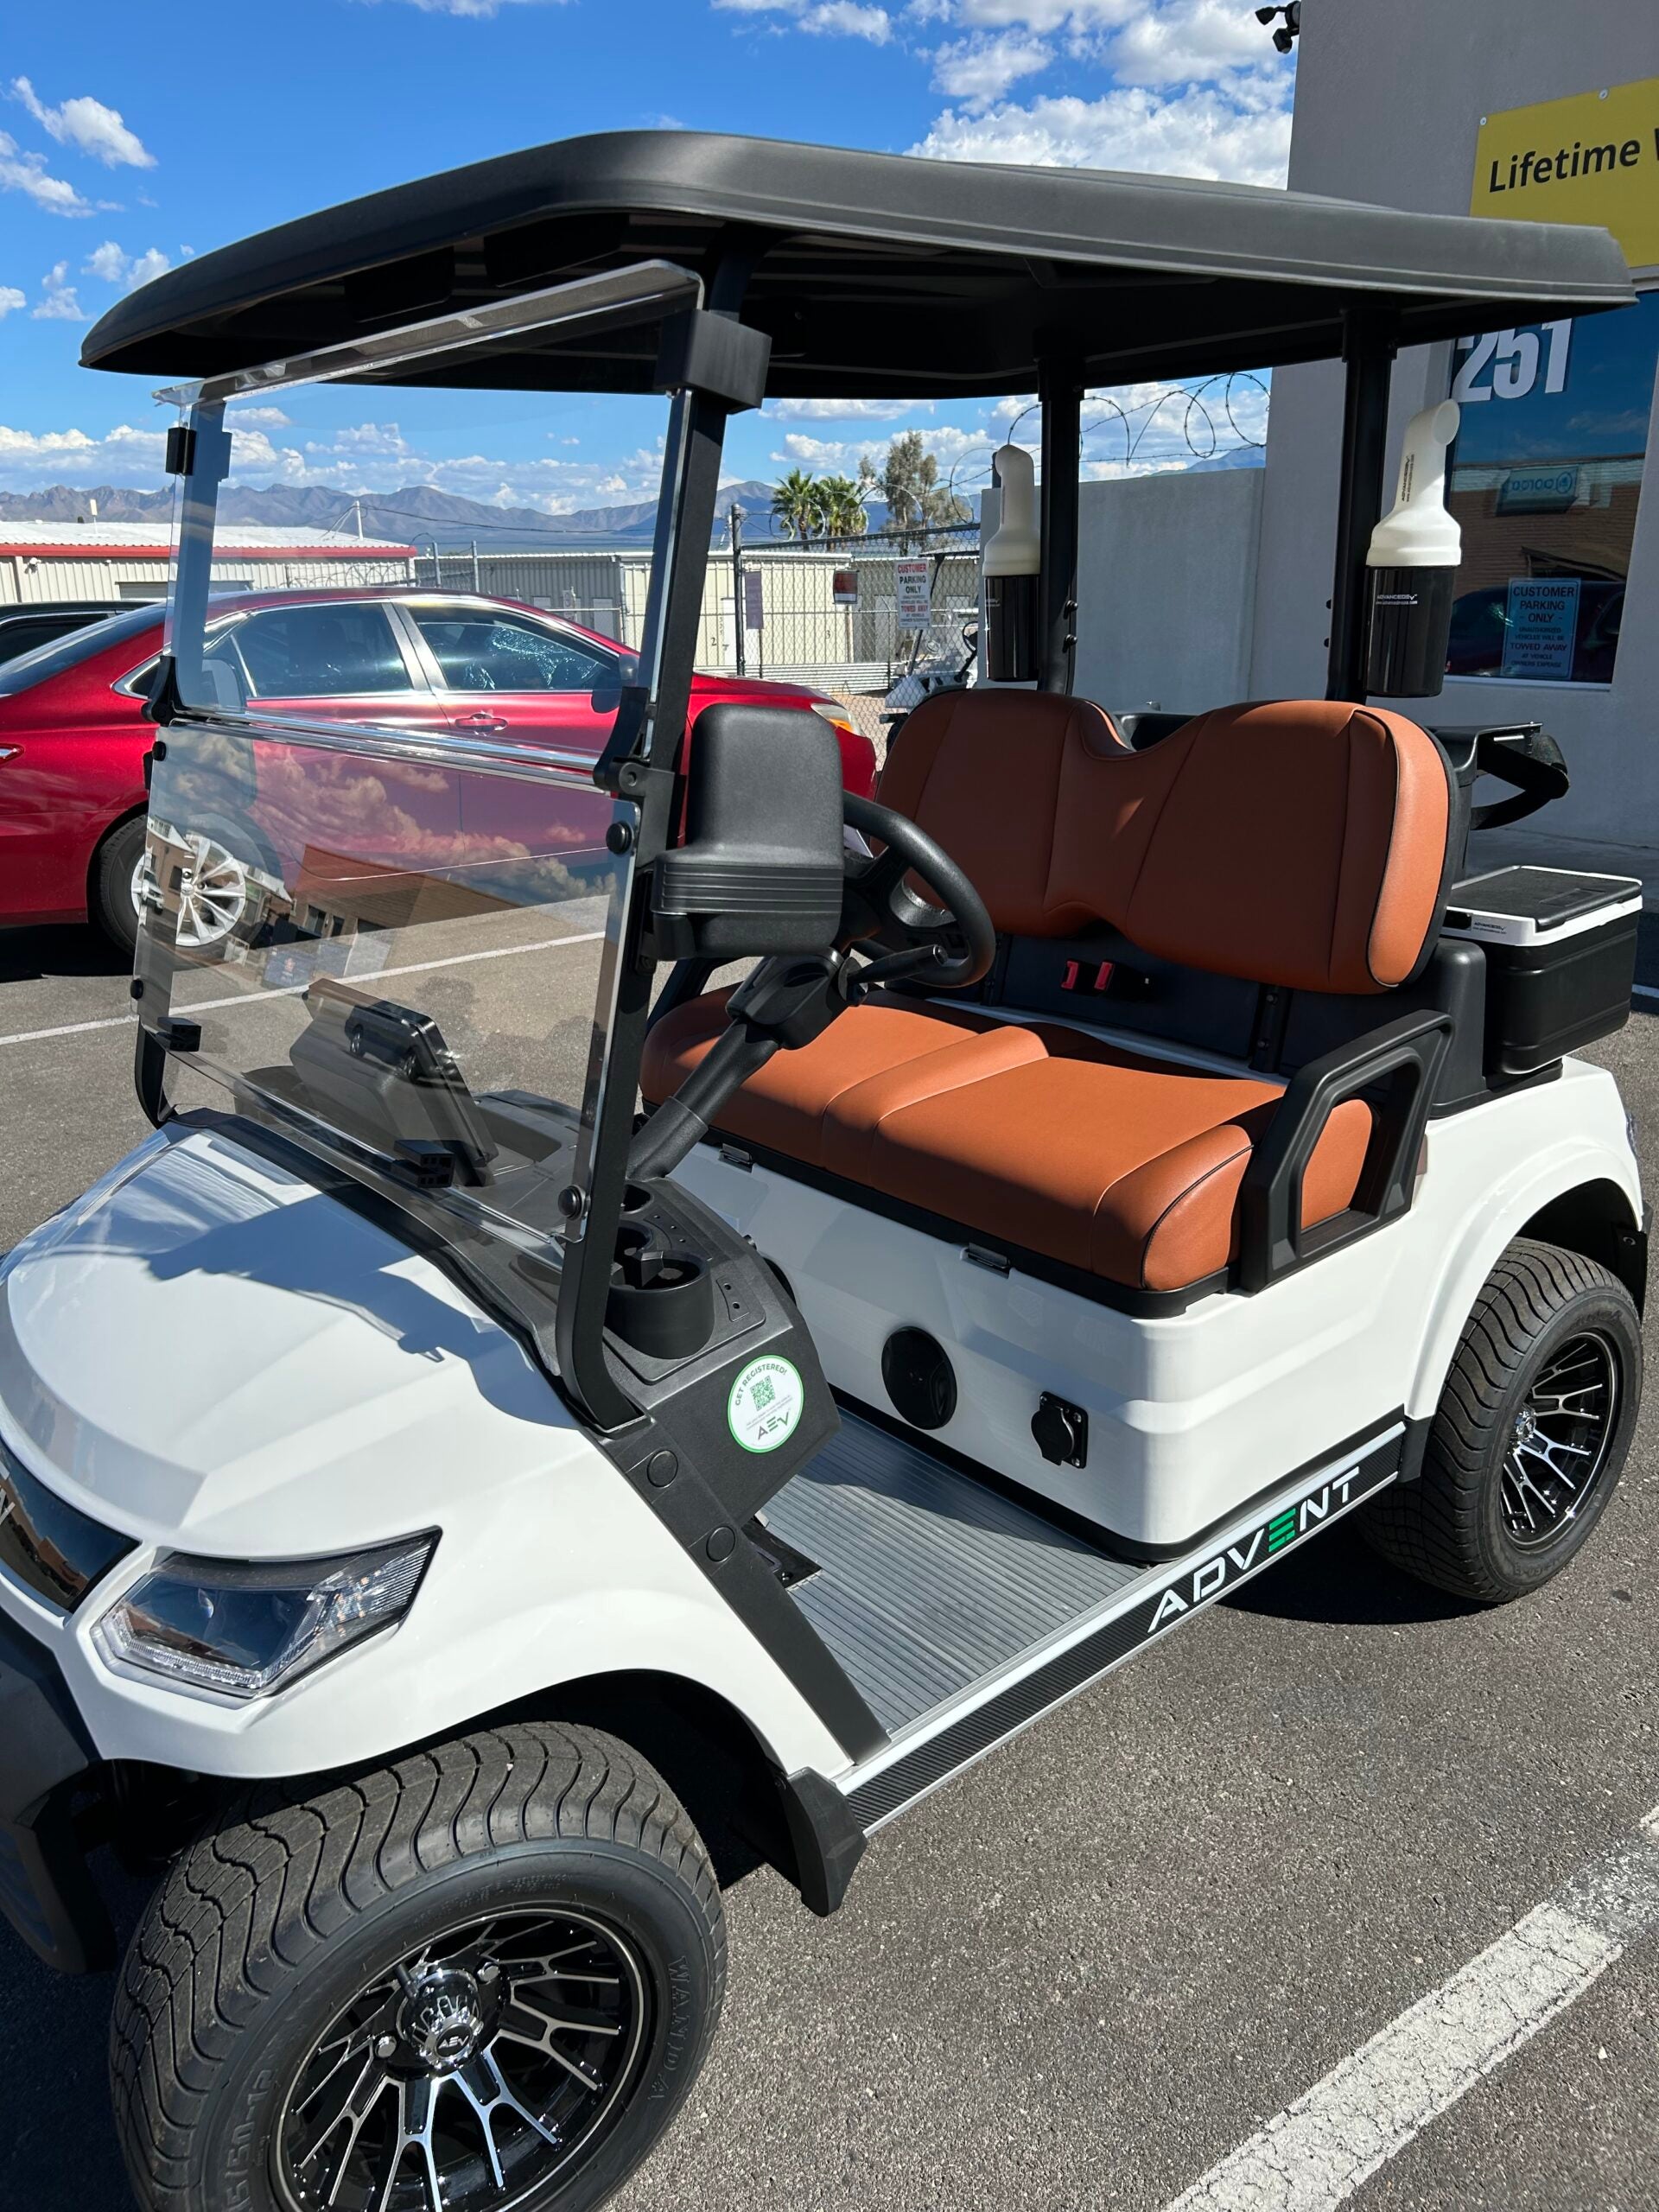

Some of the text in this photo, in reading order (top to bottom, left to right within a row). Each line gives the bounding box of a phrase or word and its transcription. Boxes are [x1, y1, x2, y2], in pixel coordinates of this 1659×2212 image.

[1489, 139, 1641, 193] Lifetime
[1452, 318, 1573, 403] 251
[898, 563, 926, 573] CUSTOMER
[899, 575, 926, 584] PARKING
[1513, 586, 1575, 597] CUSTOMER
[1520, 601, 1565, 611] PARKING
[1528, 613, 1554, 622] ONLY
[710, 637, 717, 646] 2
[1510, 642, 1541, 651] TOWED
[734, 1363, 787, 1406] GET REGISTERED!
[1147, 1466, 1359, 1633] ADVENT
[647, 1955, 691, 2101] WANDA
[437, 2036, 469, 2050] AEV
[219, 2069, 273, 2212] 15/50-12
